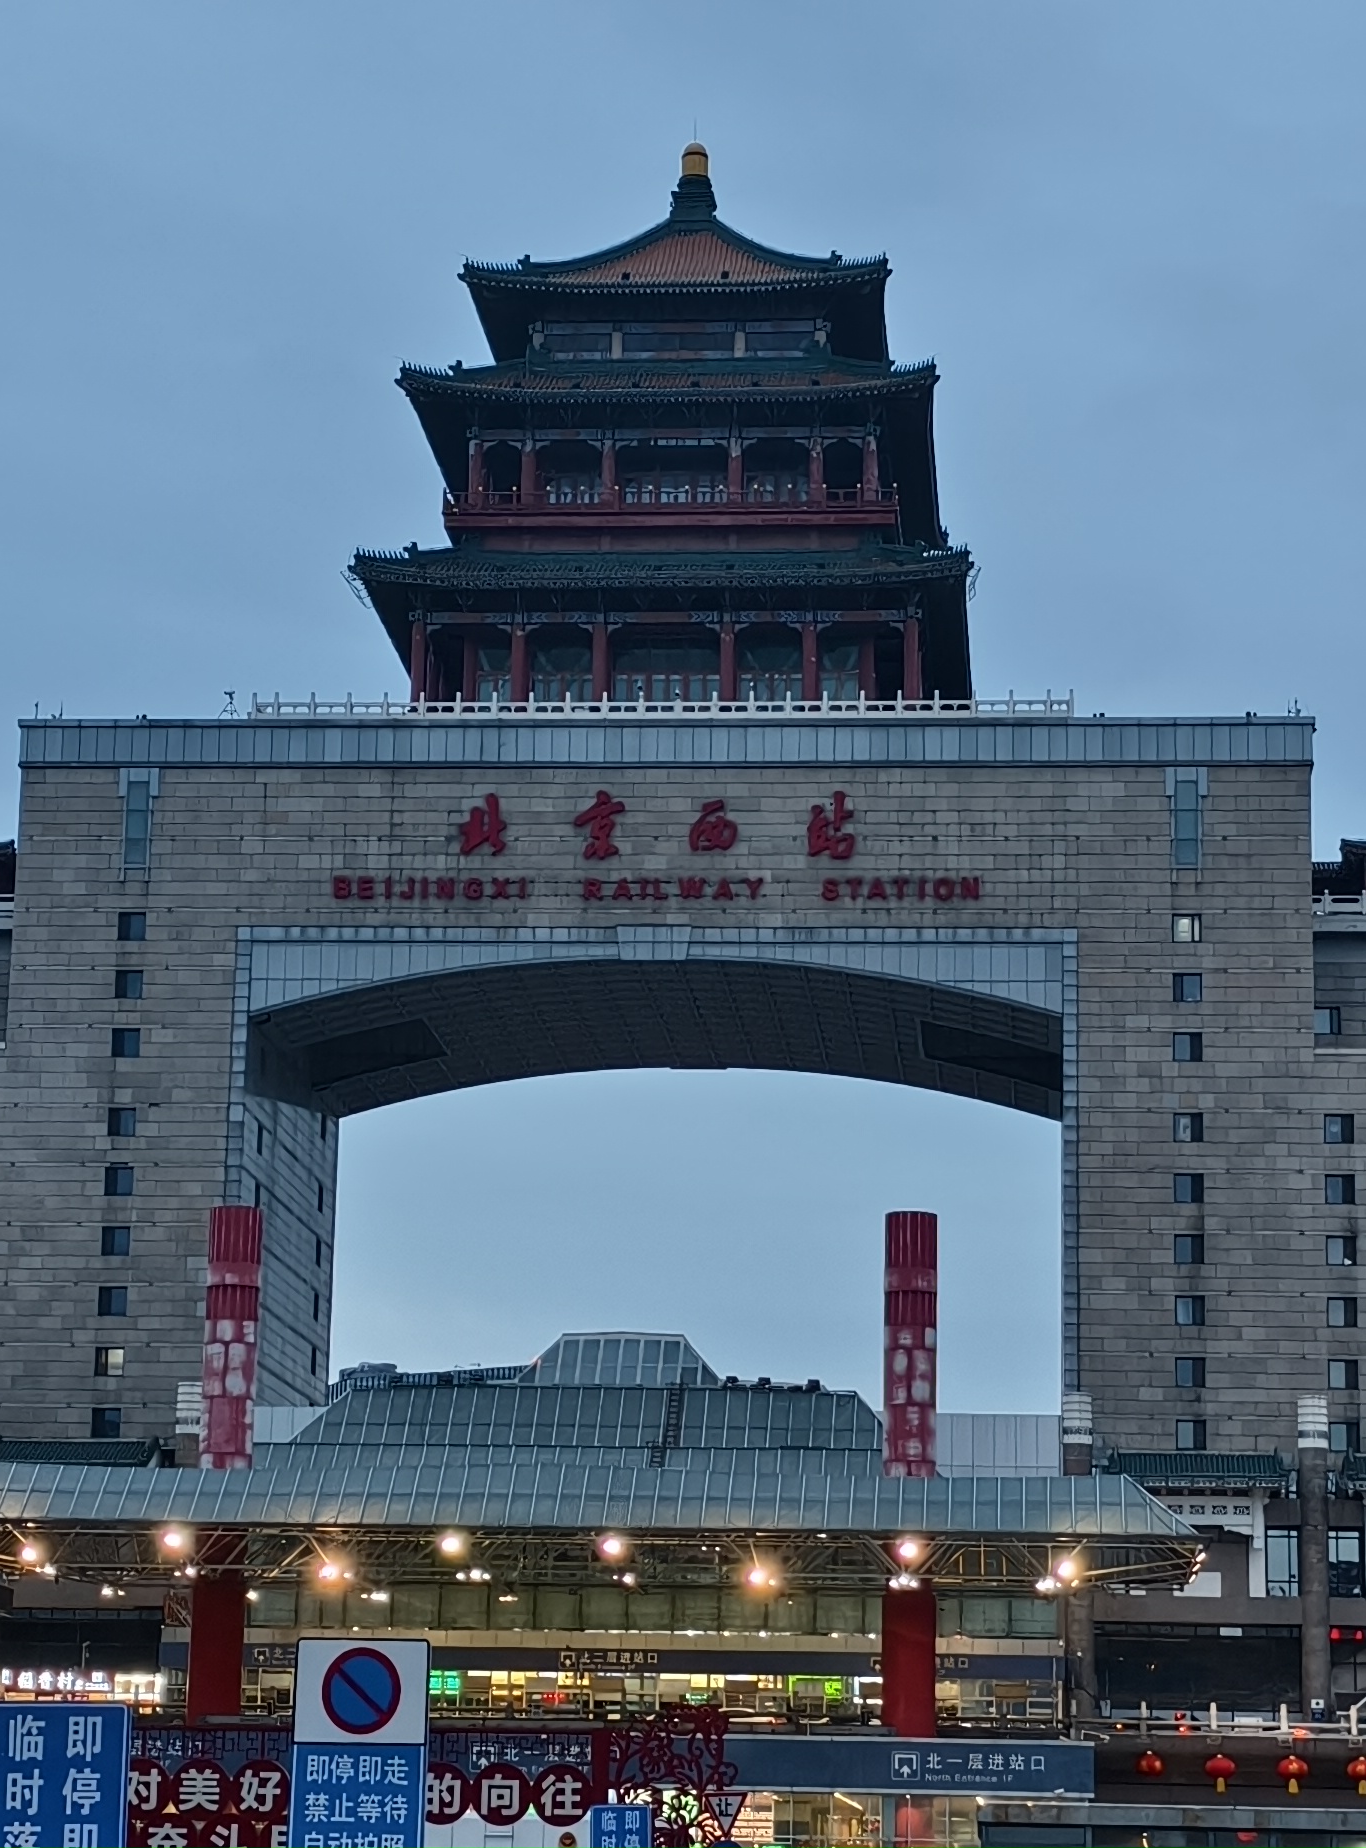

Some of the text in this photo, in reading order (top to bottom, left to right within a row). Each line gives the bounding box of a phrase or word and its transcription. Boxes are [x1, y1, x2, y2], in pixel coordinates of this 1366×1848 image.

[461, 791, 855, 861] 北京西站
[333, 875, 981, 900] BEIJINGXI RAILWAY STATION
[306, 1755, 409, 1785] 即停即走
[925, 1753, 1045, 1771] 北一层进站口
[129, 1769, 282, 1812] 对美好
[427, 1773, 583, 1817] 的向往
[304, 1792, 409, 1824] 禁止等待
[716, 1797, 734, 1818] 让
